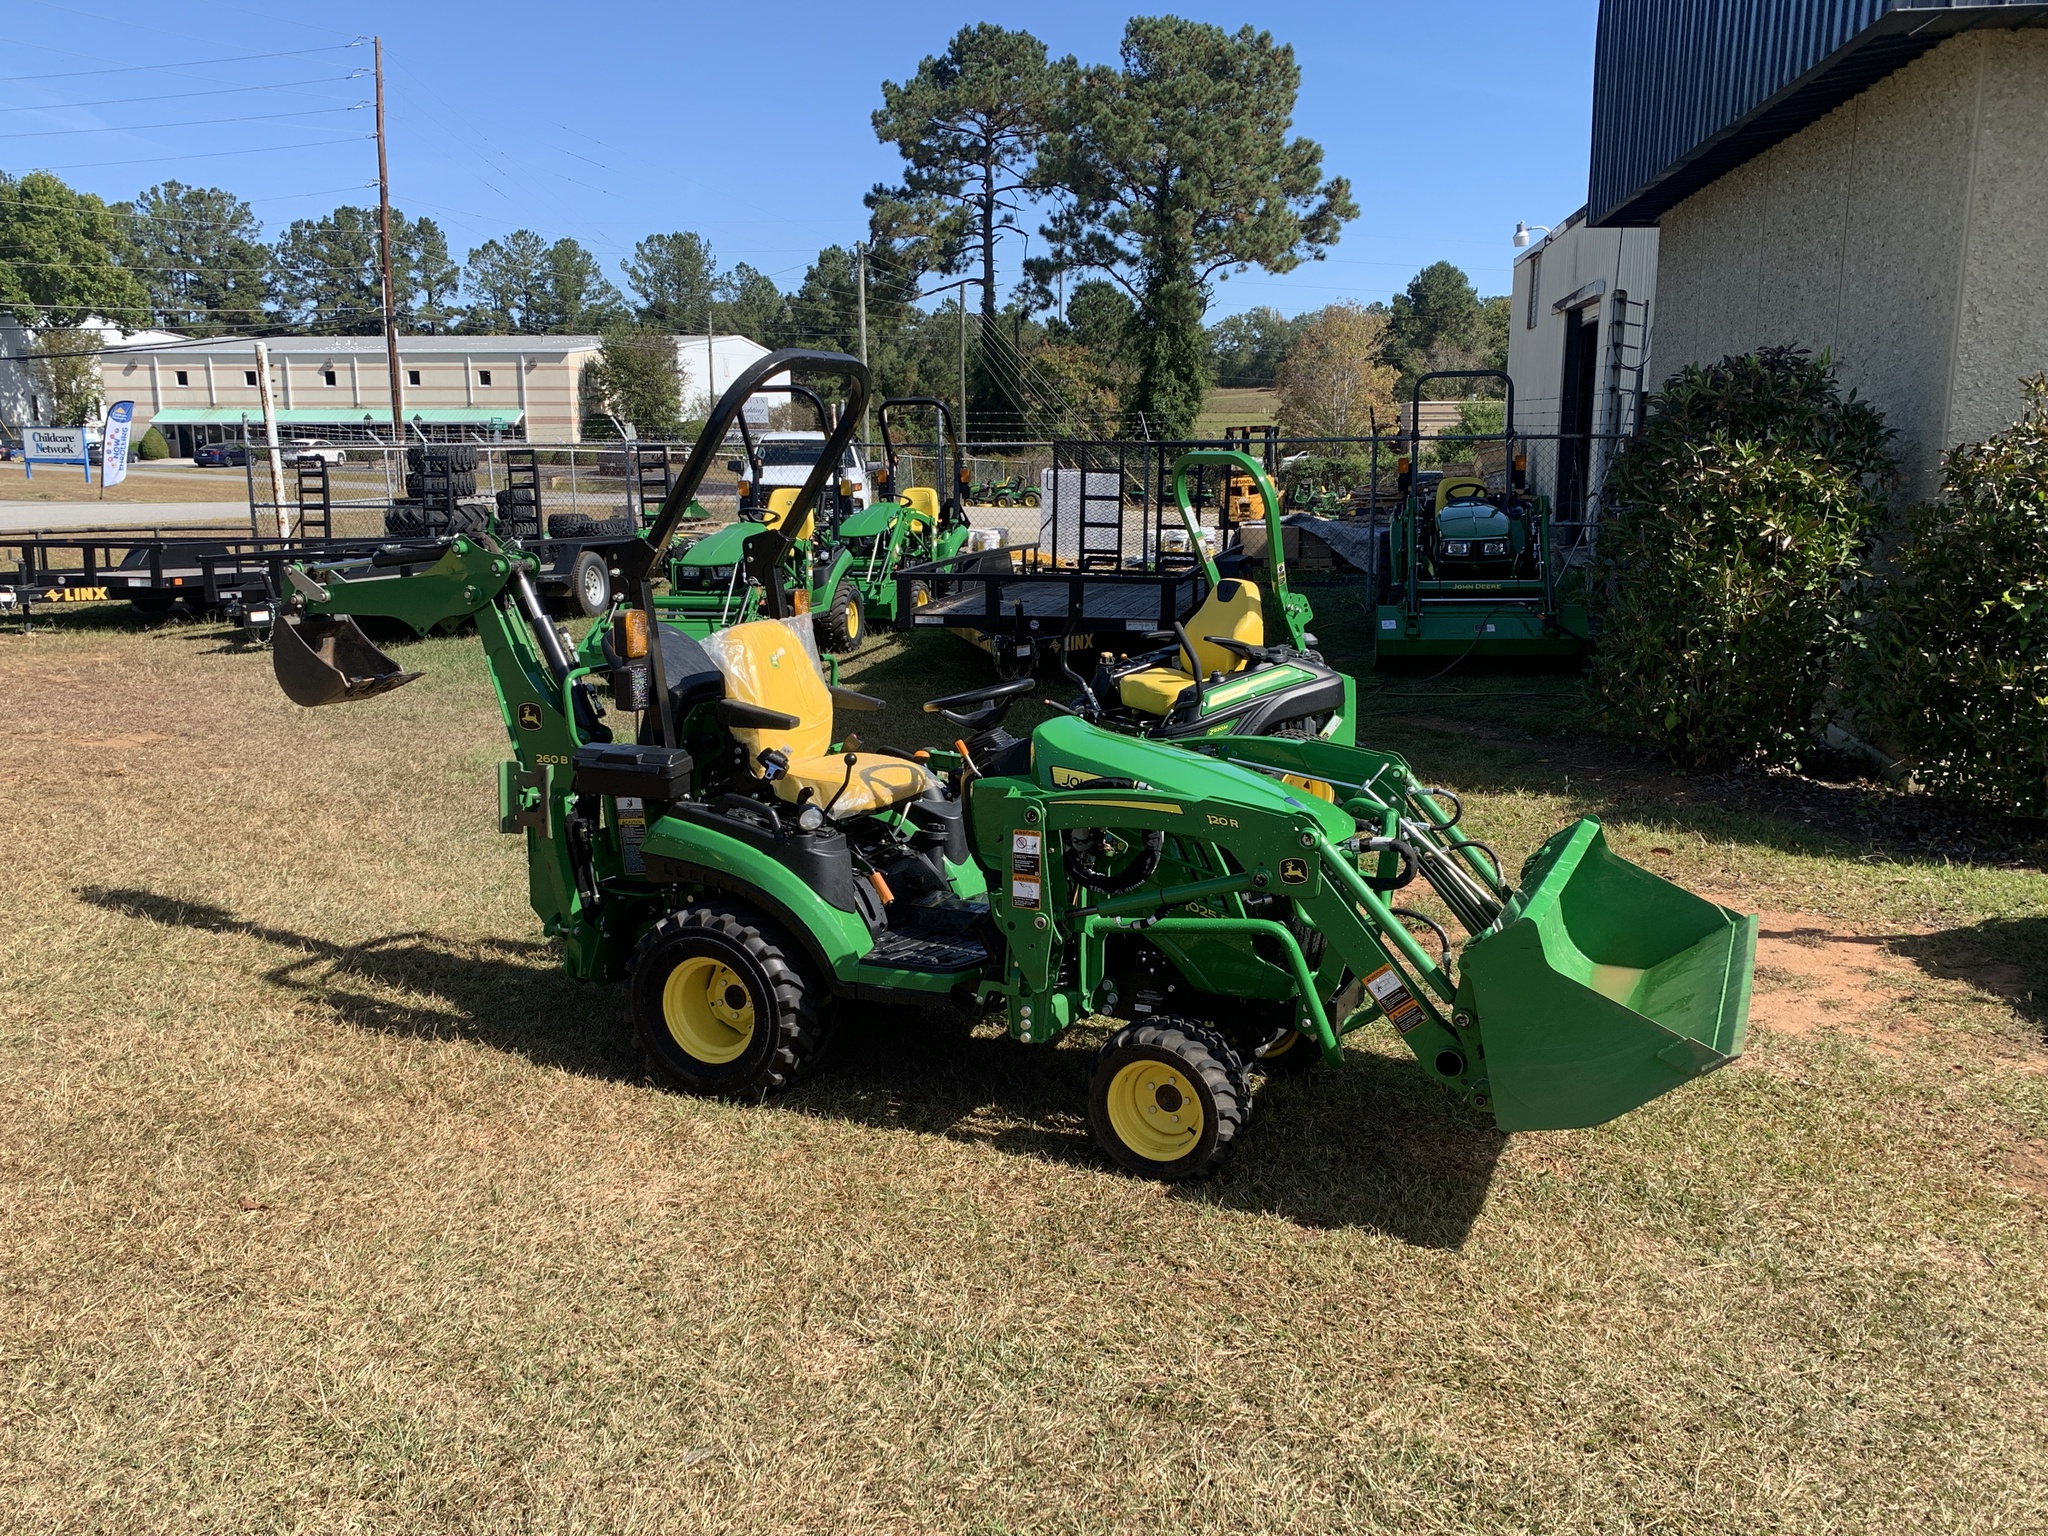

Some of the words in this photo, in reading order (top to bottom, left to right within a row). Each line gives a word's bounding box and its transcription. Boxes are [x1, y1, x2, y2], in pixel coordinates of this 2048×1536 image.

[743, 406, 765, 415] ighting
[32, 431, 75, 443] Childcare
[35, 442, 75, 454] Network
[119, 427, 129, 471] ENROLLING
[64, 586, 108, 602] LINX
[1070, 633, 1094, 651] INX
[536, 754, 559, 764] 260
[561, 755, 569, 765] B
[1206, 814, 1228, 826] 120
